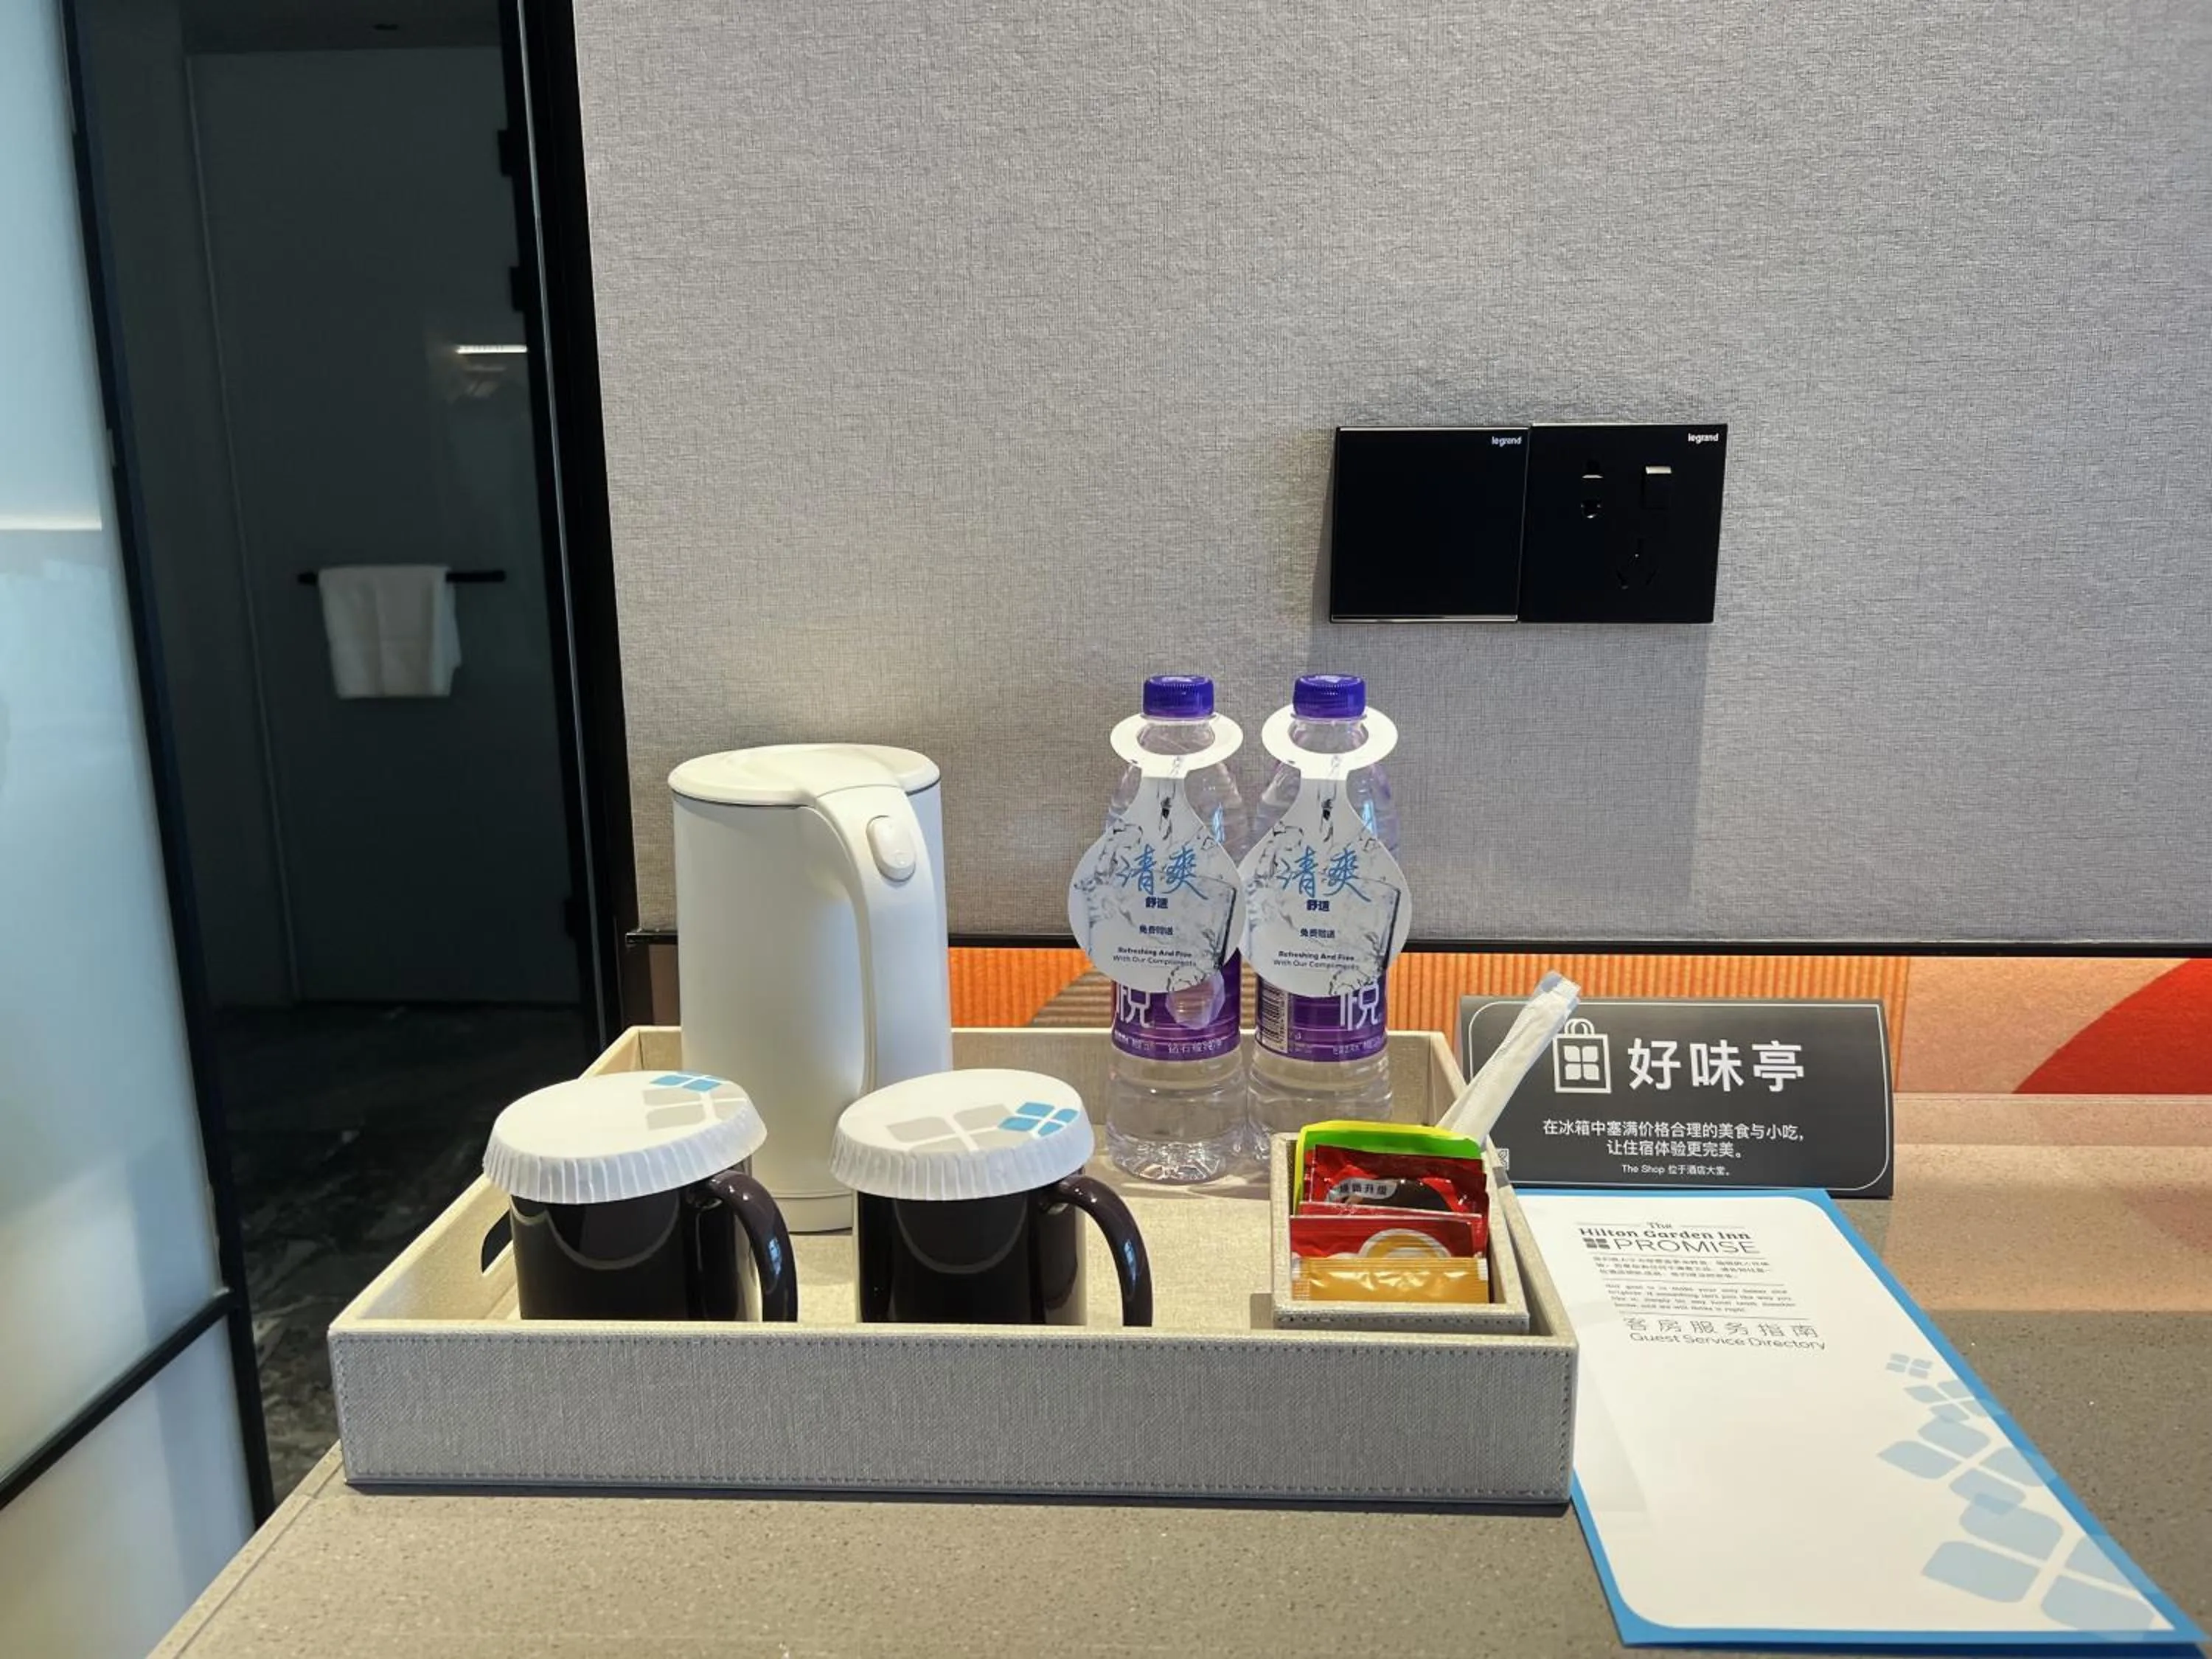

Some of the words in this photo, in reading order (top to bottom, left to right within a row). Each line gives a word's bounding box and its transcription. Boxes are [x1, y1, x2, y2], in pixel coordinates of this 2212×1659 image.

[1491, 436, 1523, 447] legrand
[1688, 433, 1719, 444] legrand
[1116, 844, 1208, 900] 清爽
[1276, 844, 1371, 902] 清爽
[1159, 948, 1175, 957] And
[1278, 950, 1319, 961] Refreshing
[1321, 953, 1336, 961] And
[1338, 953, 1354, 961] Free
[1627, 1037, 1804, 1093] 好味亭
[1607, 1140, 1742, 1159] 让住宿体验更完美。
[1622, 1164, 1639, 1173] The
[1641, 1164, 1665, 1175] Shop
[1668, 1164, 1730, 1177] 位于酒店大堂。
[1646, 1221, 1673, 1230] The
[1579, 1227, 1639, 1238] Hilton
[1644, 1230, 1714, 1239] Garden
[1718, 1231, 1752, 1240] Inn
[1613, 1238, 1761, 1254] PROMISE
[1623, 1317, 1820, 1338] 客房服务指南
[1630, 1332, 1681, 1343] Guest
[1683, 1334, 1745, 1346] Service
[1748, 1337, 1826, 1351] Directory
